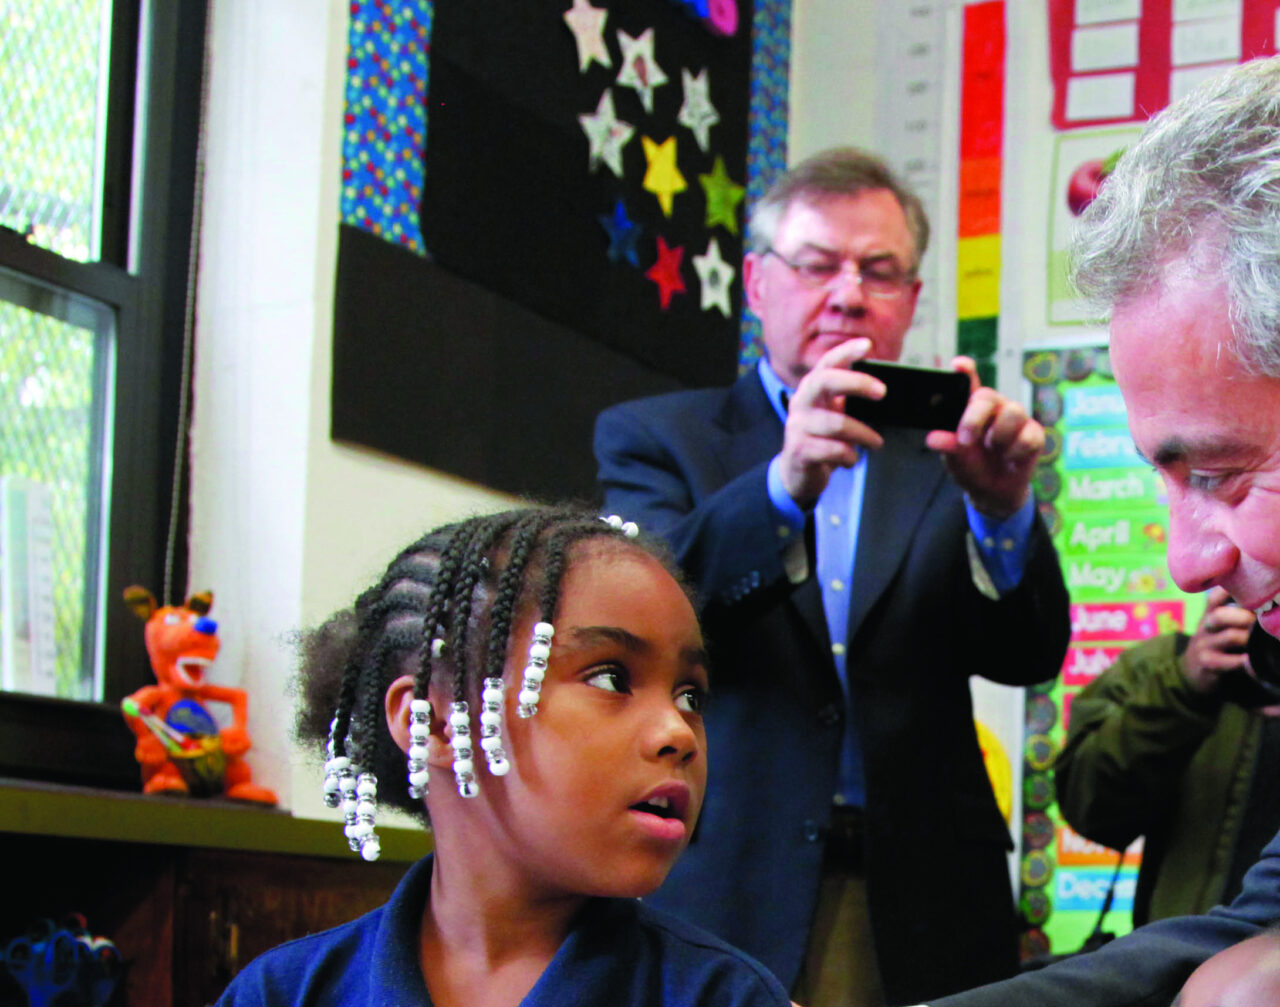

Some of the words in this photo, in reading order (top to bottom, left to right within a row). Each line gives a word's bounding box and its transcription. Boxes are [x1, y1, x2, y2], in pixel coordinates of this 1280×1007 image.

[1067, 471, 1145, 500] March
[1070, 518, 1130, 552] April
[1069, 560, 1127, 593] May
[1070, 605, 1128, 633] June
